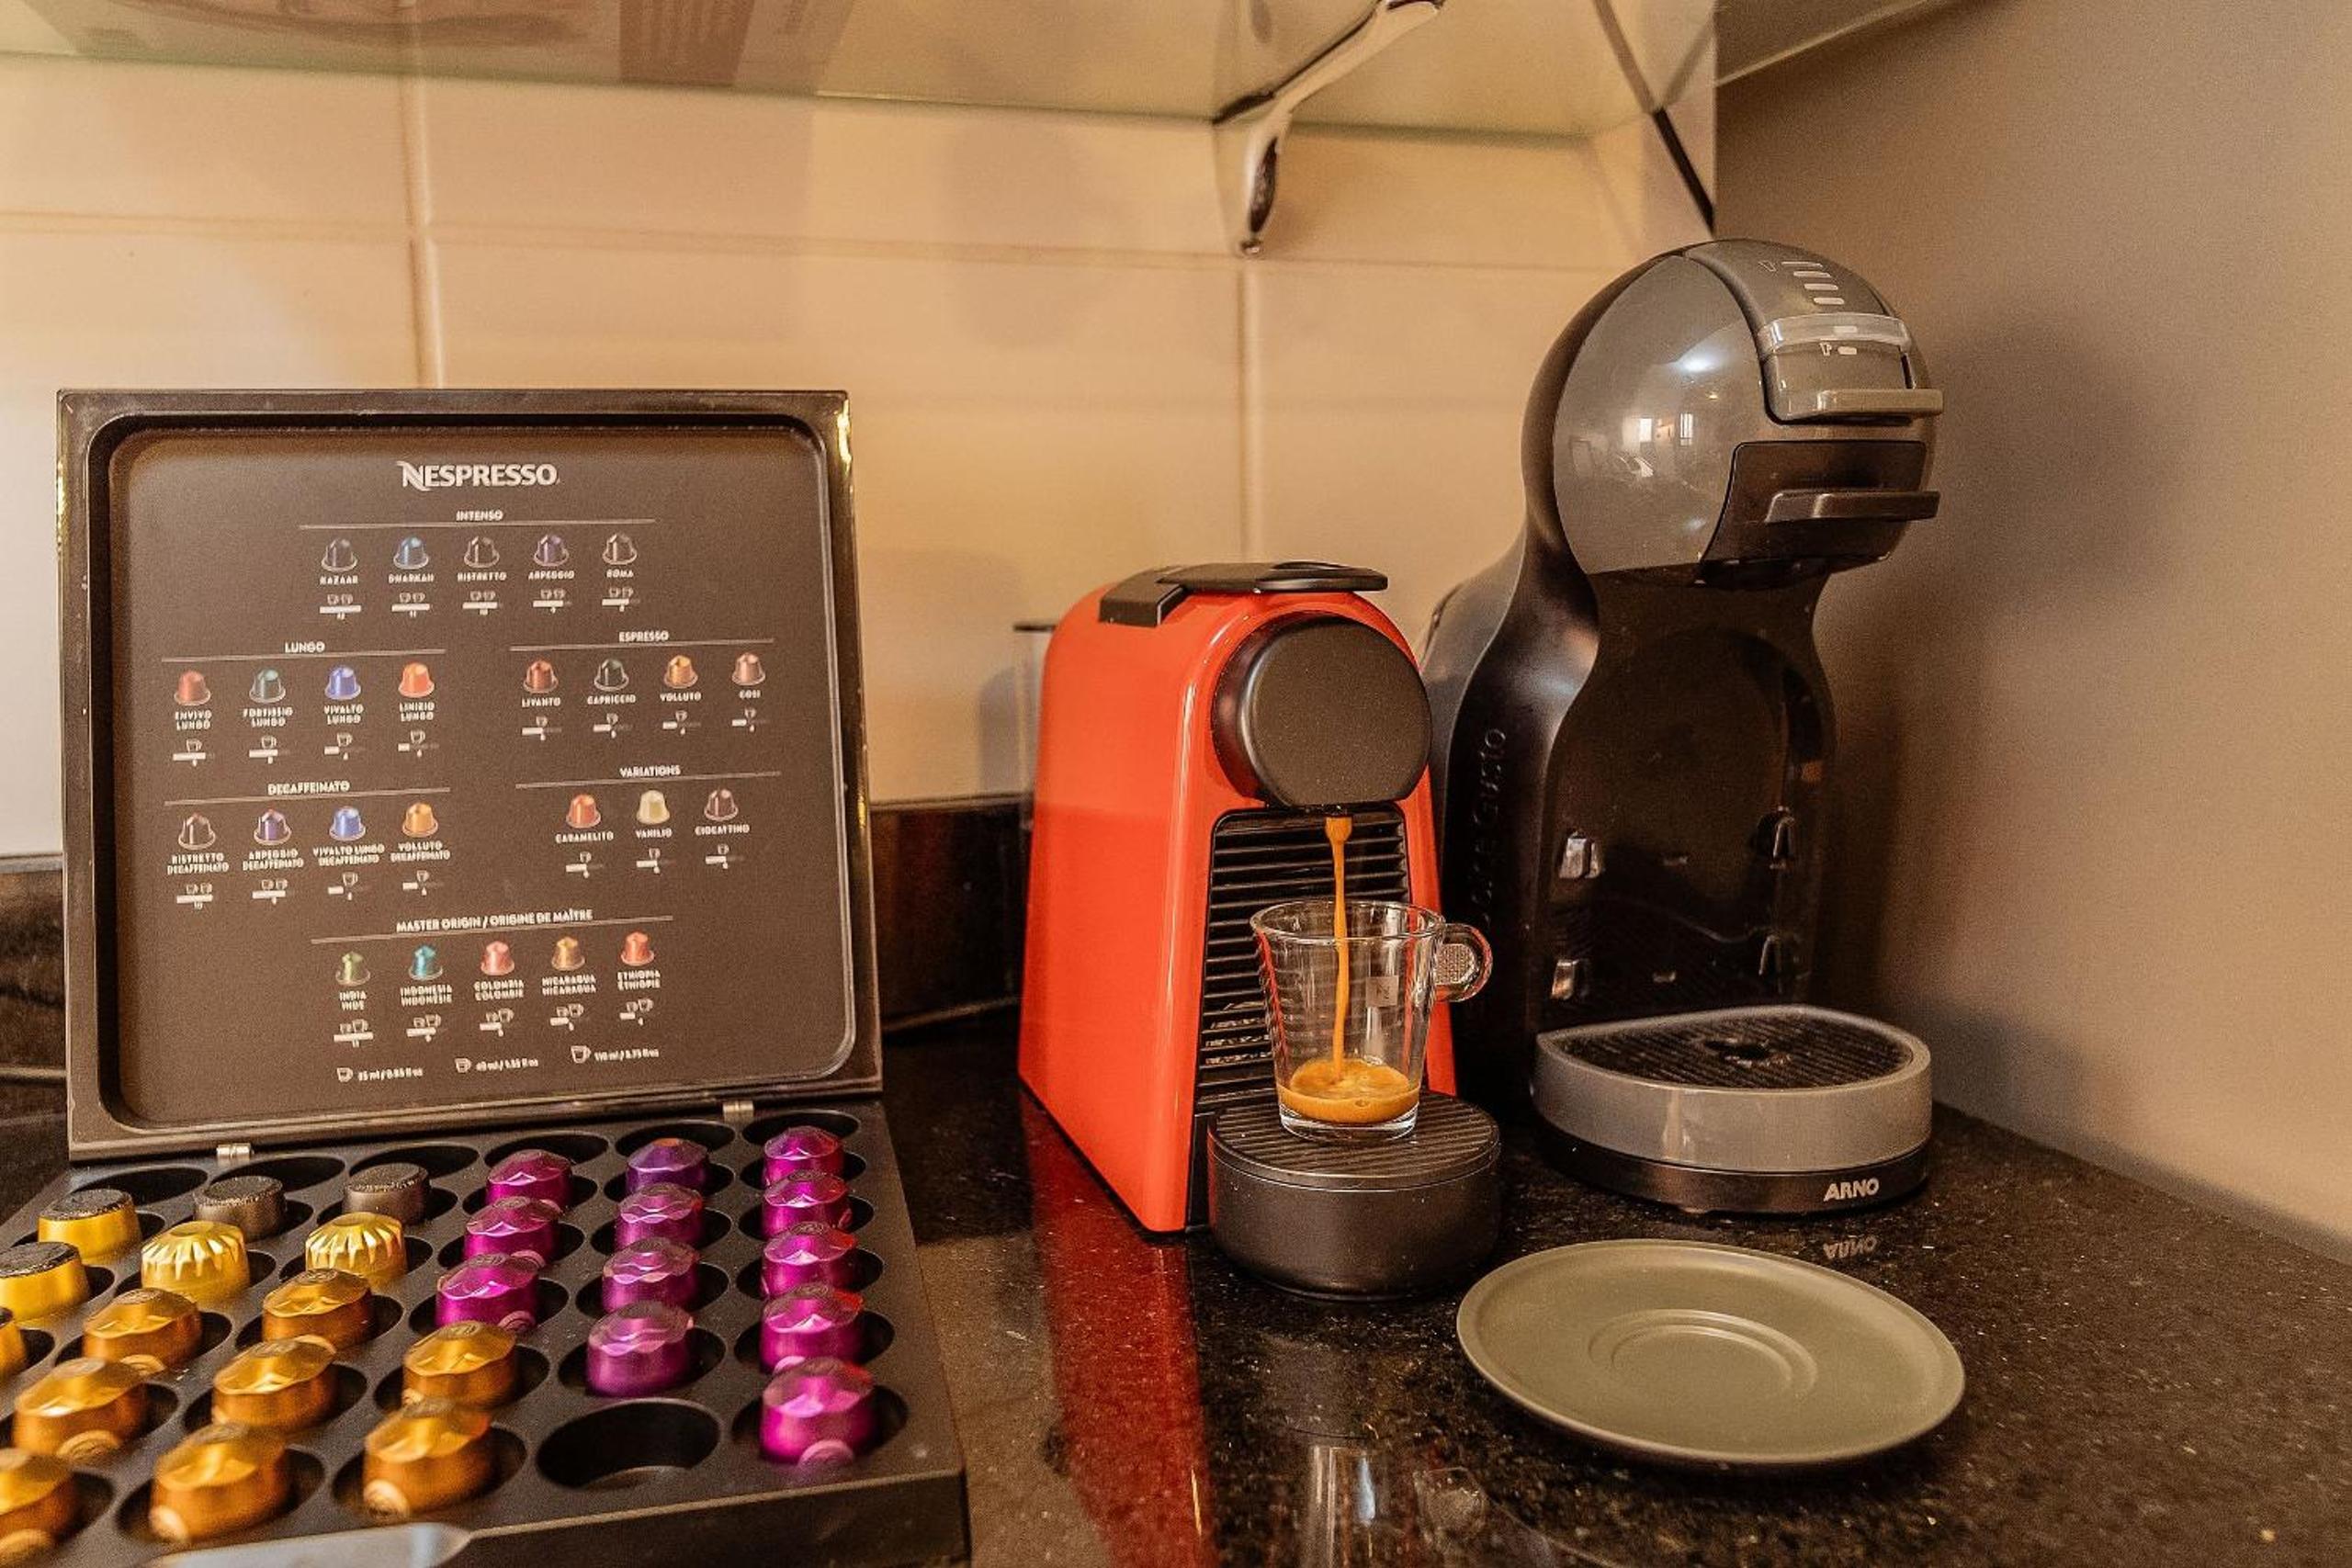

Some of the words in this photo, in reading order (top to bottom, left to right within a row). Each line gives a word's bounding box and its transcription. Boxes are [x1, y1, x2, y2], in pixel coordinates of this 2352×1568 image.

[396, 460, 558, 491] NESPRESSO
[456, 510, 503, 522] INTENSO
[458, 571, 507, 581] RISTRETTO
[528, 570, 575, 580] ARPEGGIO
[606, 569, 634, 578] ROMA
[618, 630, 669, 642] ESPRESSO
[285, 641, 325, 653] LUNGO
[521, 697, 560, 708] LIVANTO
[587, 694, 636, 705] CAPRICCIO
[660, 691, 702, 702] VOLLUTO
[323, 704, 364, 715] VIVALTO
[401, 712, 434, 722] LUNGO
[619, 765, 681, 777] VARIATIONS
[267, 781, 350, 795] DECAFFEINATO
[555, 830, 614, 843] CARAMELITO
[312, 845, 353, 856] VIVALTO
[398, 840, 443, 852] VOLLUTO
[396, 919, 439, 932] MASTER
[441, 917, 481, 930] ORIGIN
[490, 912, 535, 927] ORIGINE
[536, 911, 551, 923] DE
[473, 979, 525, 992] COLOMBIA
[1823, 1178, 1880, 1201] ARNO
